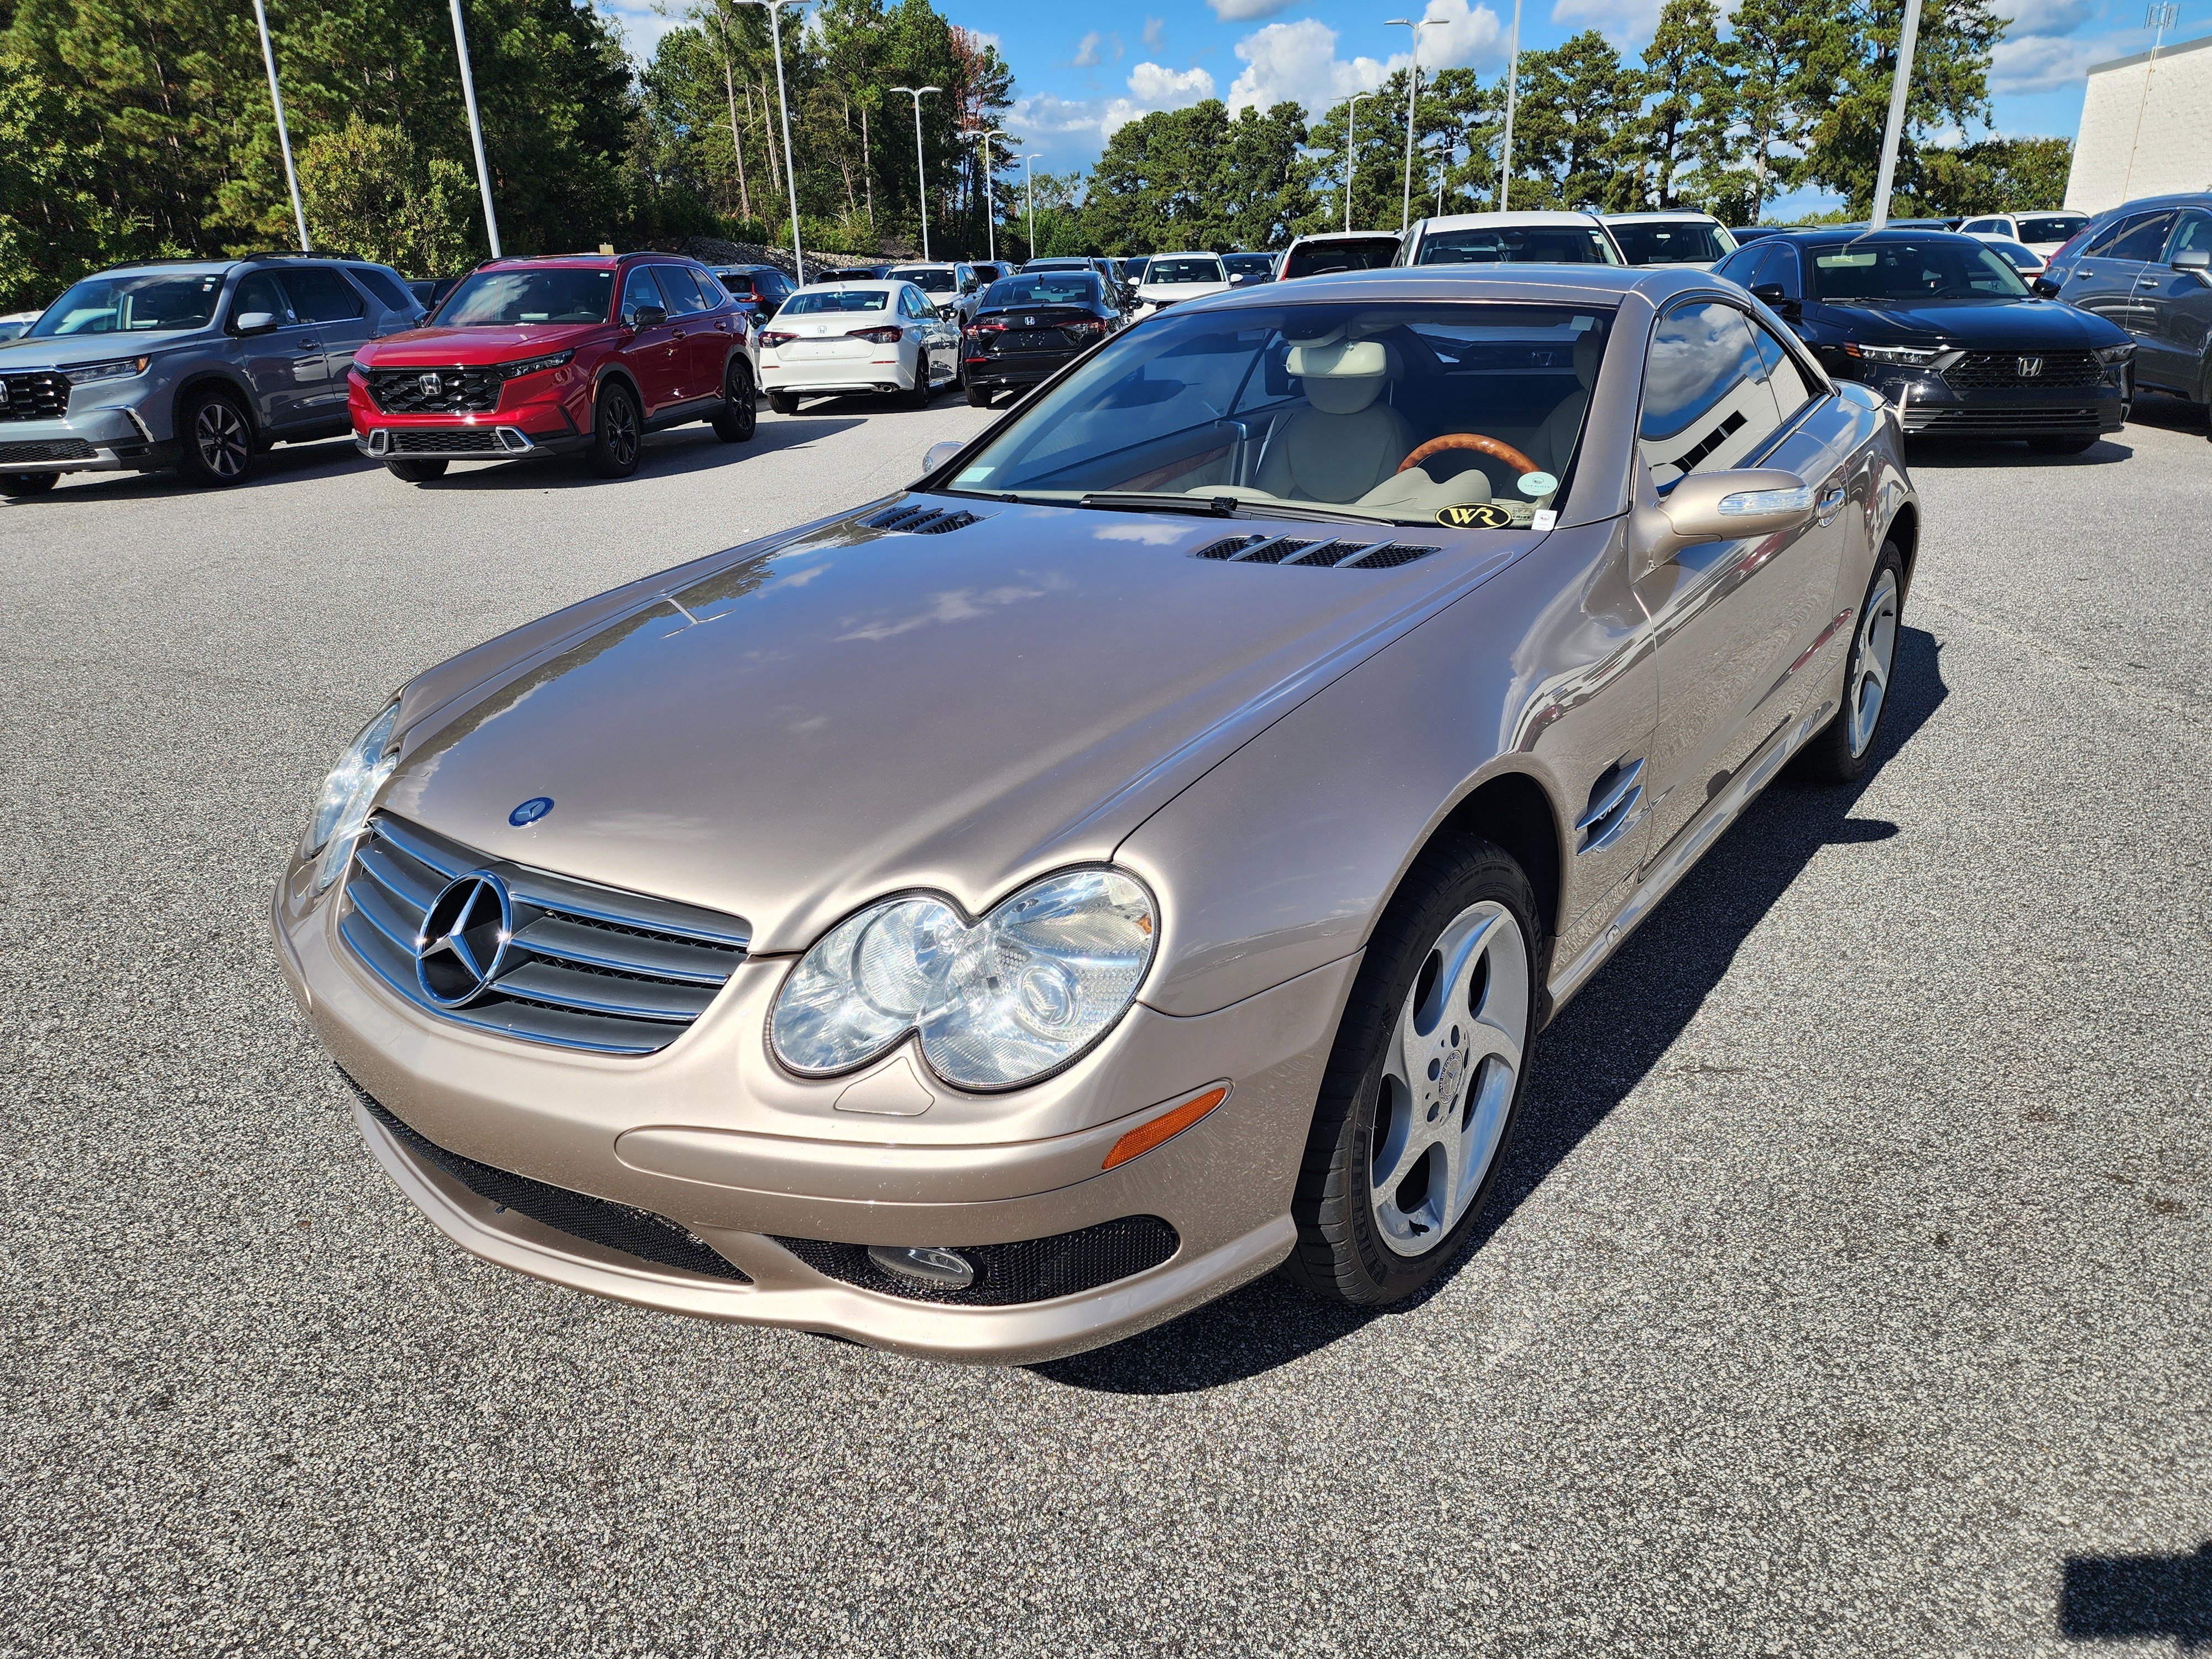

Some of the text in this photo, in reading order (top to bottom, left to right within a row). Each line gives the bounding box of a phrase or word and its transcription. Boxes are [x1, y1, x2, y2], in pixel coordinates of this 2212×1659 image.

[1448, 507, 1500, 525] WR
[1360, 1067, 1373, 1117] 255/40
[1439, 1053, 1454, 1089] MERCEDES
[1352, 1141, 1378, 1267] MICHELIN
